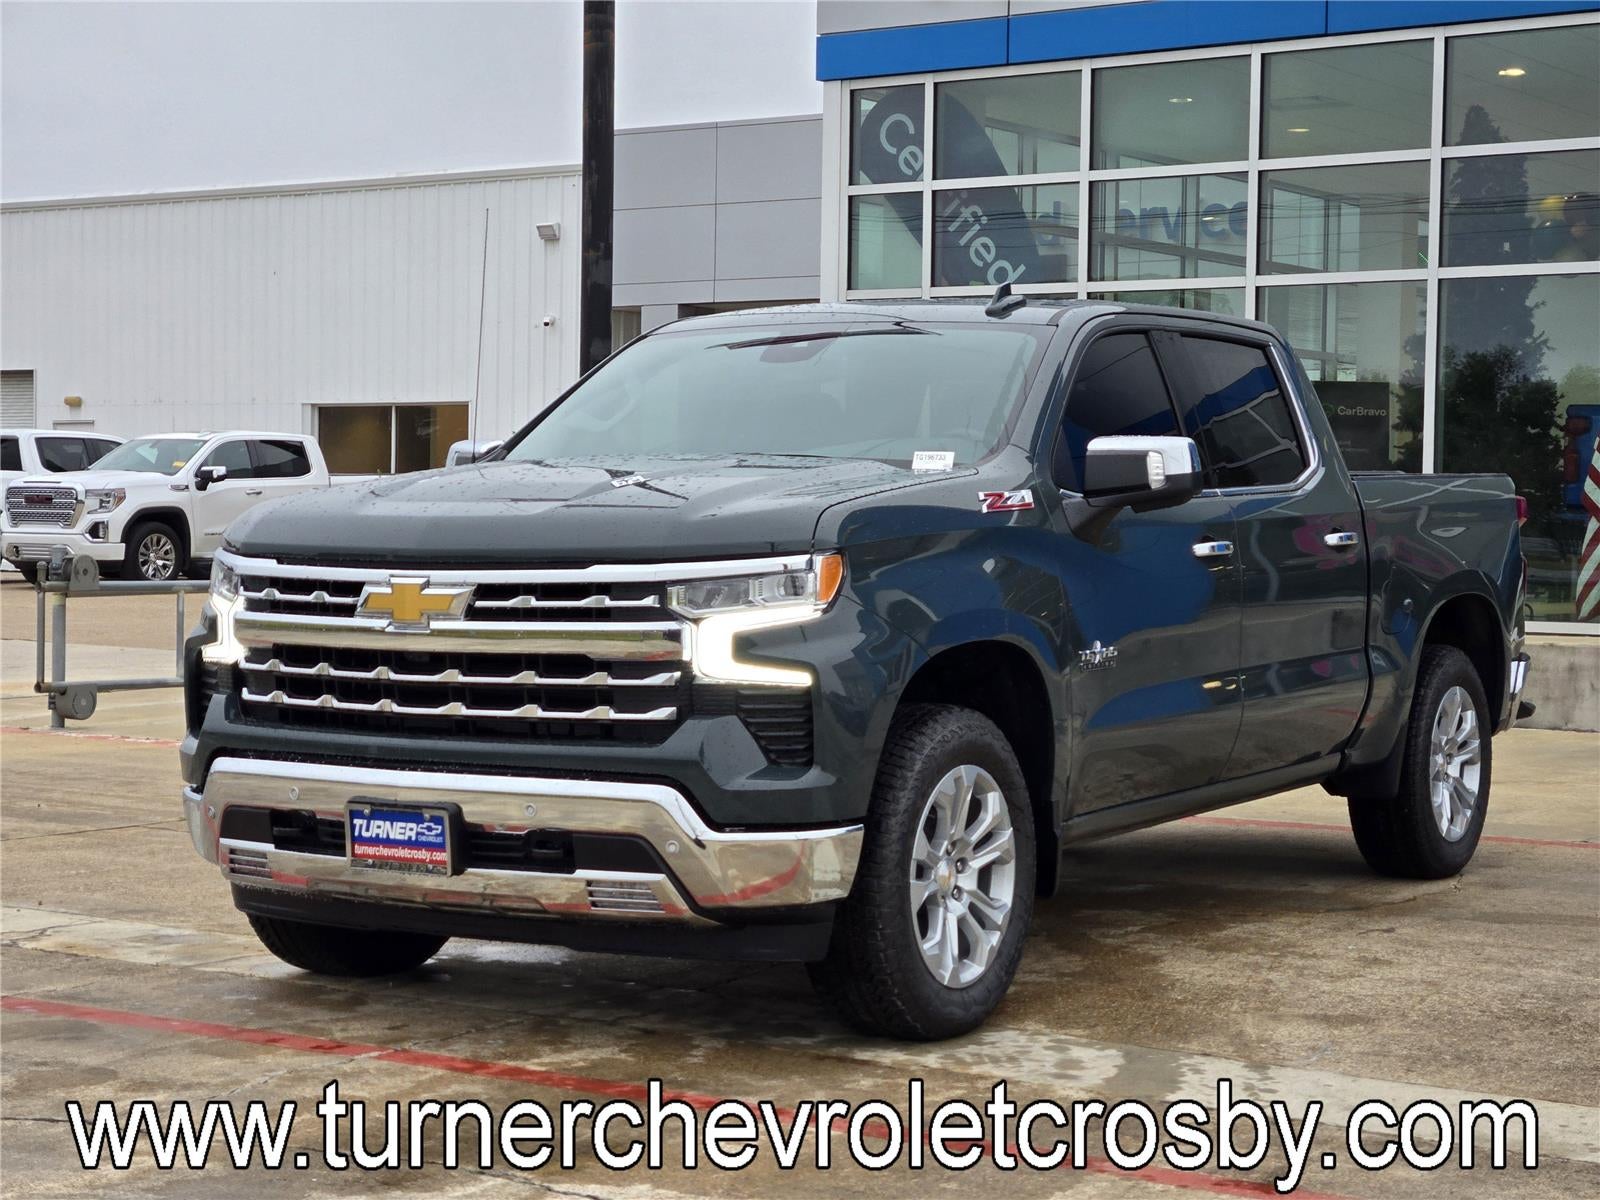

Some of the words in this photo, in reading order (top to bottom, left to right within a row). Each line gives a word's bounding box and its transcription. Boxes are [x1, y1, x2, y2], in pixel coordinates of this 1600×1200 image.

[879, 112, 1027, 286] Ceified
[1337, 406, 1388, 416] CarBravo
[353, 819, 417, 841] TURNER
[354, 844, 448, 862] turnerchevroletcrosby.com
